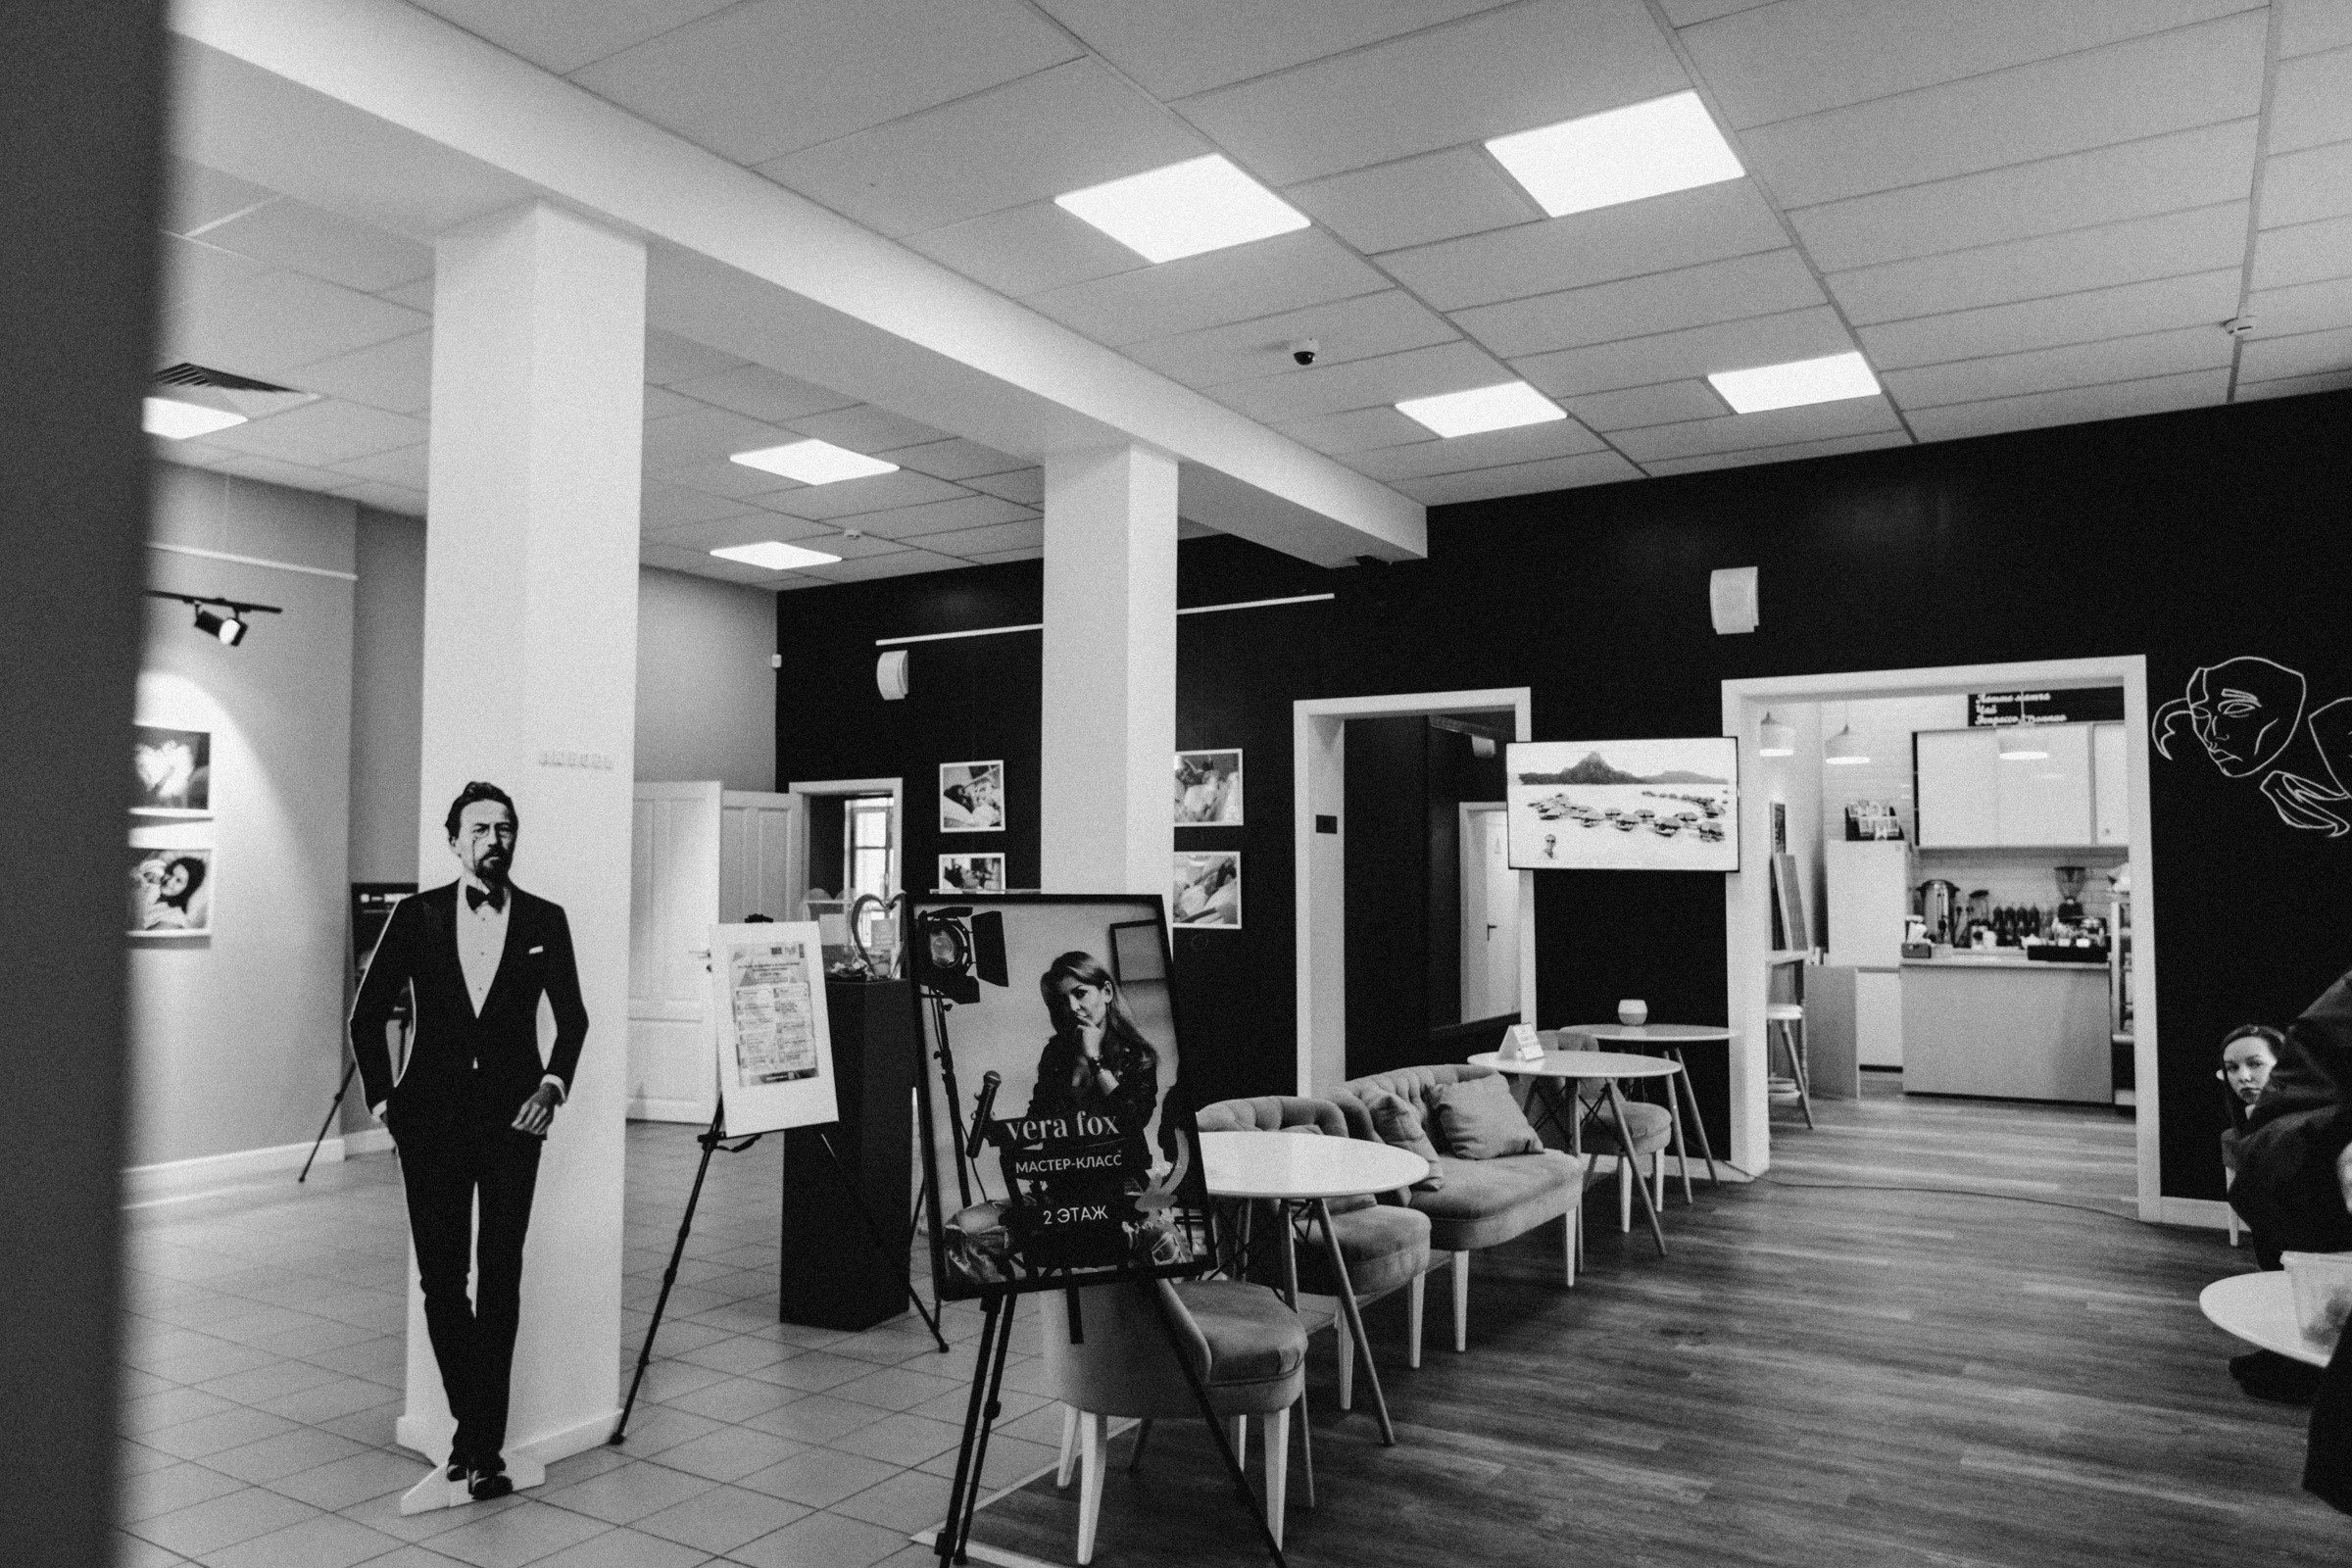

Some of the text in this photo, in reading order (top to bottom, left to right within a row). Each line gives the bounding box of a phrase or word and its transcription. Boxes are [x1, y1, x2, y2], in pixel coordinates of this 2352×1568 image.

[1005, 1110, 1120, 1141] vera fox
[1015, 1153, 1122, 1174] МАСТЕР-КЛАСС
[1043, 1204, 1109, 1226] 2 ЭТАЖ
